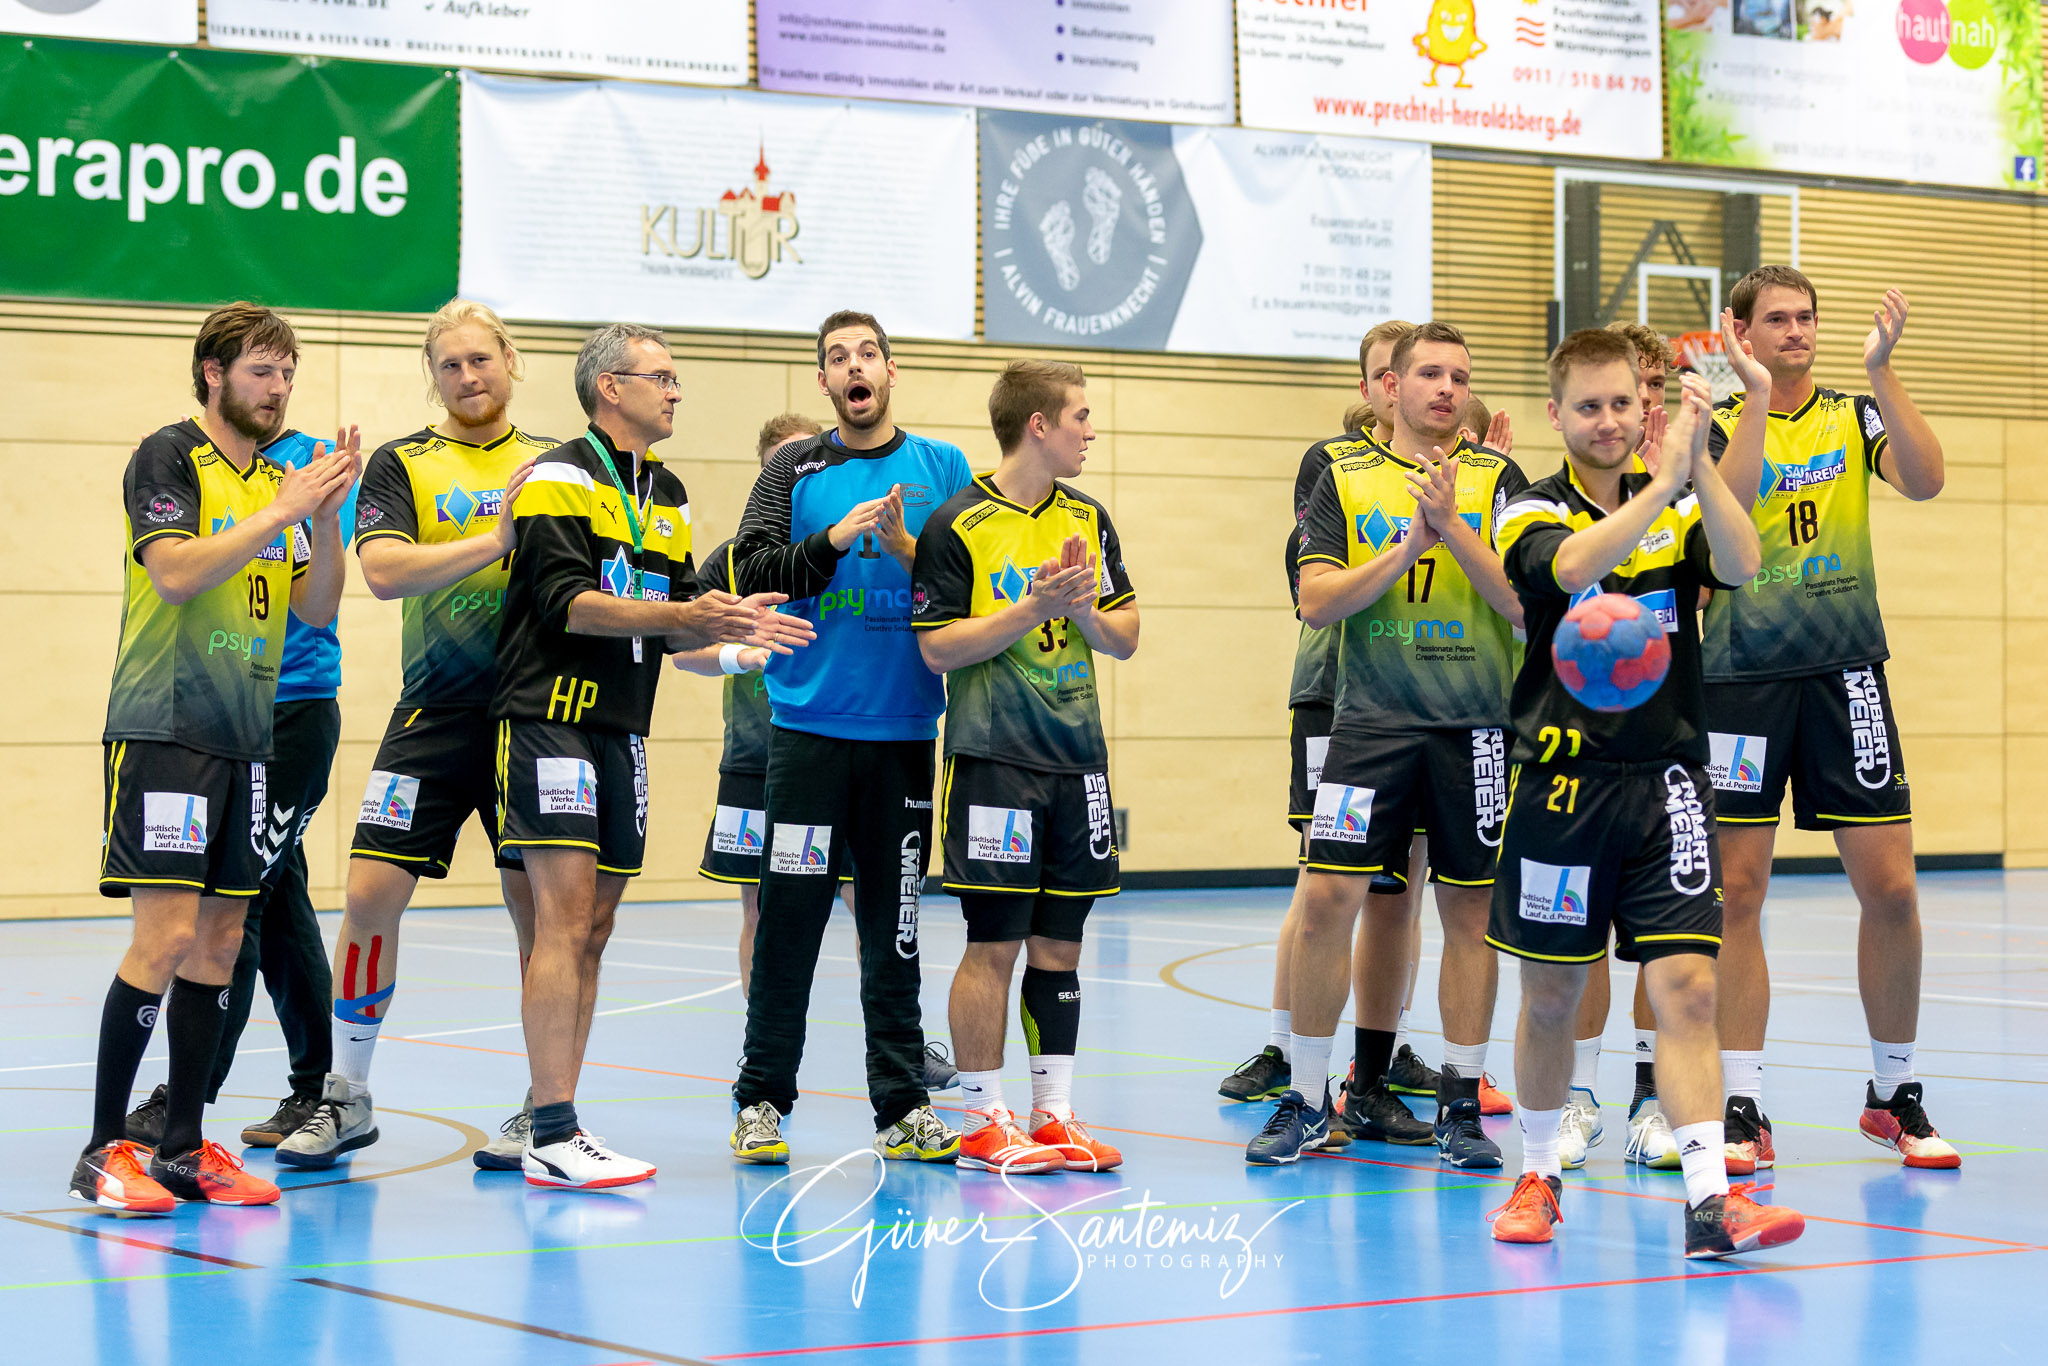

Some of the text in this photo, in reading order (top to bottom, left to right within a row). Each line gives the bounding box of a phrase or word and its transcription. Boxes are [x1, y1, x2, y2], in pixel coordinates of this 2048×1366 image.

[443, 1, 530, 18] Aufkleber
[1631, 75, 1652, 93] 70
[1313, 95, 1582, 140] www.prechtel-heroldsberg.de
[0, 133, 408, 222] erapro.de
[994, 178, 1020, 230] IHRE
[1052, 126, 1073, 148] IN
[1128, 162, 1166, 245] HÄNDEN
[640, 203, 804, 280] KULTUR
[1000, 264, 1161, 335] ALVIN FRAUENKNECHT
[794, 459, 827, 475] Kempa
[1785, 500, 1819, 547] 18
[1407, 557, 1436, 604] 17
[1753, 553, 1841, 593] psyma
[248, 573, 270, 621] 19
[450, 588, 506, 620] psy
[864, 615, 901, 623] Passionate
[1369, 619, 1464, 645] psyma
[208, 629, 266, 661] psym
[1415, 644, 1454, 653] Passionate
[1415, 653, 1445, 662] Creative
[546, 675, 599, 723] HP
[1843, 671, 1875, 772] MEIER
[1862, 670, 1891, 770] ROBERT
[1472, 728, 1495, 832] MEIER
[1488, 728, 1507, 822] ROBERT
[1733, 781, 1761, 791] Pegnitz
[250, 762, 263, 837] EIER
[539, 787, 576, 796] Städtische
[550, 795, 575, 803] Werke
[1546, 774, 1580, 814] 21
[1084, 774, 1103, 842] EIER
[145, 824, 181, 833] Städtische
[383, 816, 410, 828] Pegnitz
[1314, 821, 1333, 829] Werke
[1665, 783, 1693, 877] MEIER
[154, 840, 171, 849] Lauf
[155, 832, 180, 841] Werke
[979, 843, 1001, 852] Werke
[1339, 831, 1366, 841] Pegnitz
[777, 864, 790, 872] Lauf
[805, 866, 827, 874] Pegnitz
[779, 858, 799, 866] Werke
[978, 851, 993, 859] Lauf
[1007, 853, 1030, 862] Pegnitz
[897, 847, 917, 944] MEIER
[1526, 902, 1551, 912] Werke
[1525, 910, 1541, 918] Lauf
[1558, 912, 1586, 923] Pegnitz
